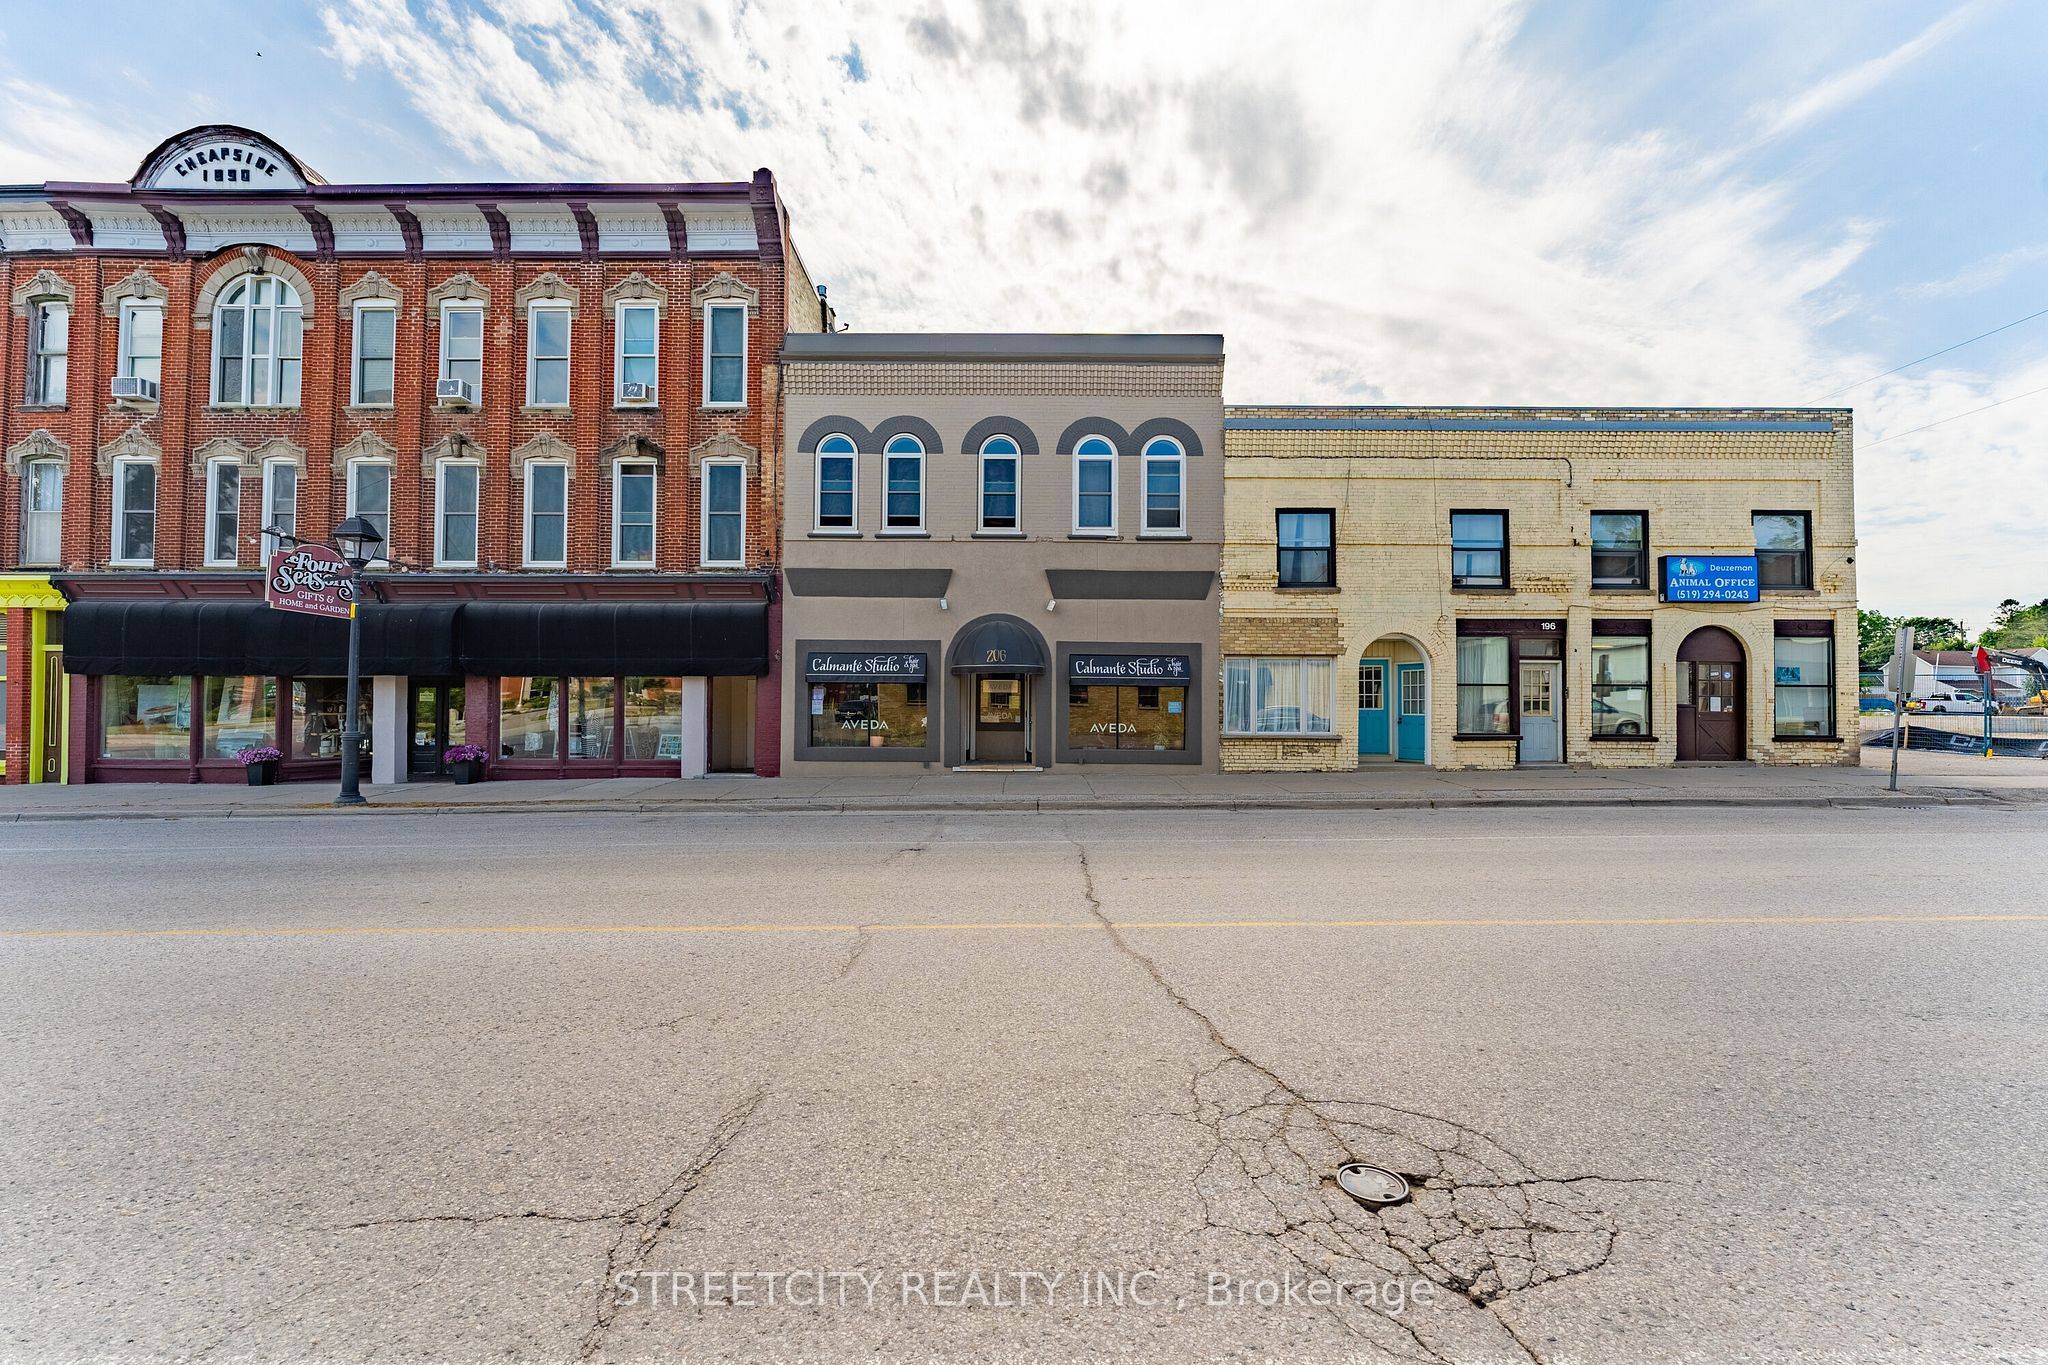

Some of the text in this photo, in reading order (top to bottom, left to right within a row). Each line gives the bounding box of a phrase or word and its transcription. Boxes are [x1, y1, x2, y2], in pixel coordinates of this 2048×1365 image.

[175, 148, 278, 177] CHEAPSIDE
[284, 552, 344, 573] Four
[1710, 564, 1753, 572] Deuzeman
[1670, 578, 1755, 588] ANIMAL OFFICE
[297, 591, 335, 604] GIFTS &
[1677, 590, 1749, 600] (519) 294-0243
[279, 598, 304, 608] HOME
[320, 605, 350, 614] GARDEN
[1541, 622, 1556, 630] 196
[864, 655, 900, 673] Studio
[1128, 658, 1164, 676] Studio
[841, 719, 889, 730] AVEDA
[1089, 723, 1137, 733] AVEDA
